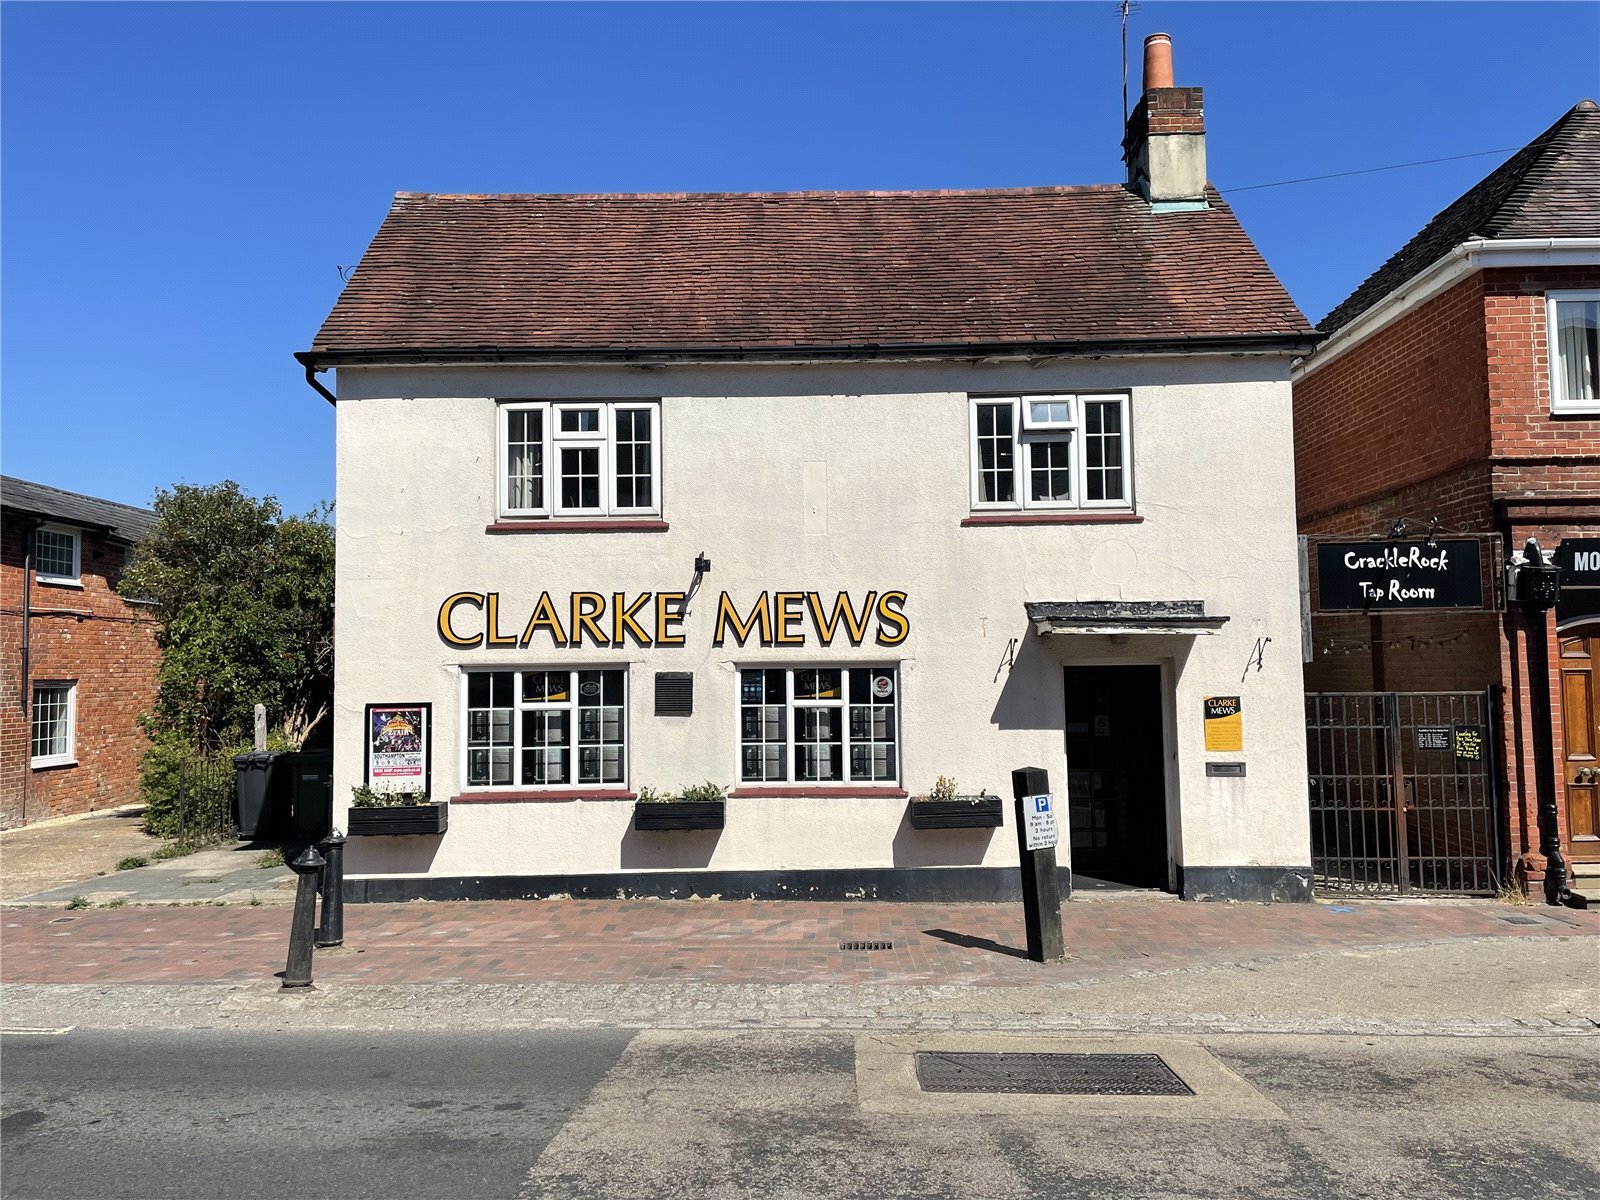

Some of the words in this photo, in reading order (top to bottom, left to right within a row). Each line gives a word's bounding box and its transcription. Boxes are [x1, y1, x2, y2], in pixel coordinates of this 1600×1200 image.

[1344, 546, 1449, 571] CrackleRock
[1358, 581, 1385, 602] Tap
[1388, 579, 1436, 602] Room
[437, 591, 686, 648] CLARKE
[712, 591, 910, 648] MEWS
[535, 685, 564, 693] MWS
[1208, 699, 1237, 707] CLARKE
